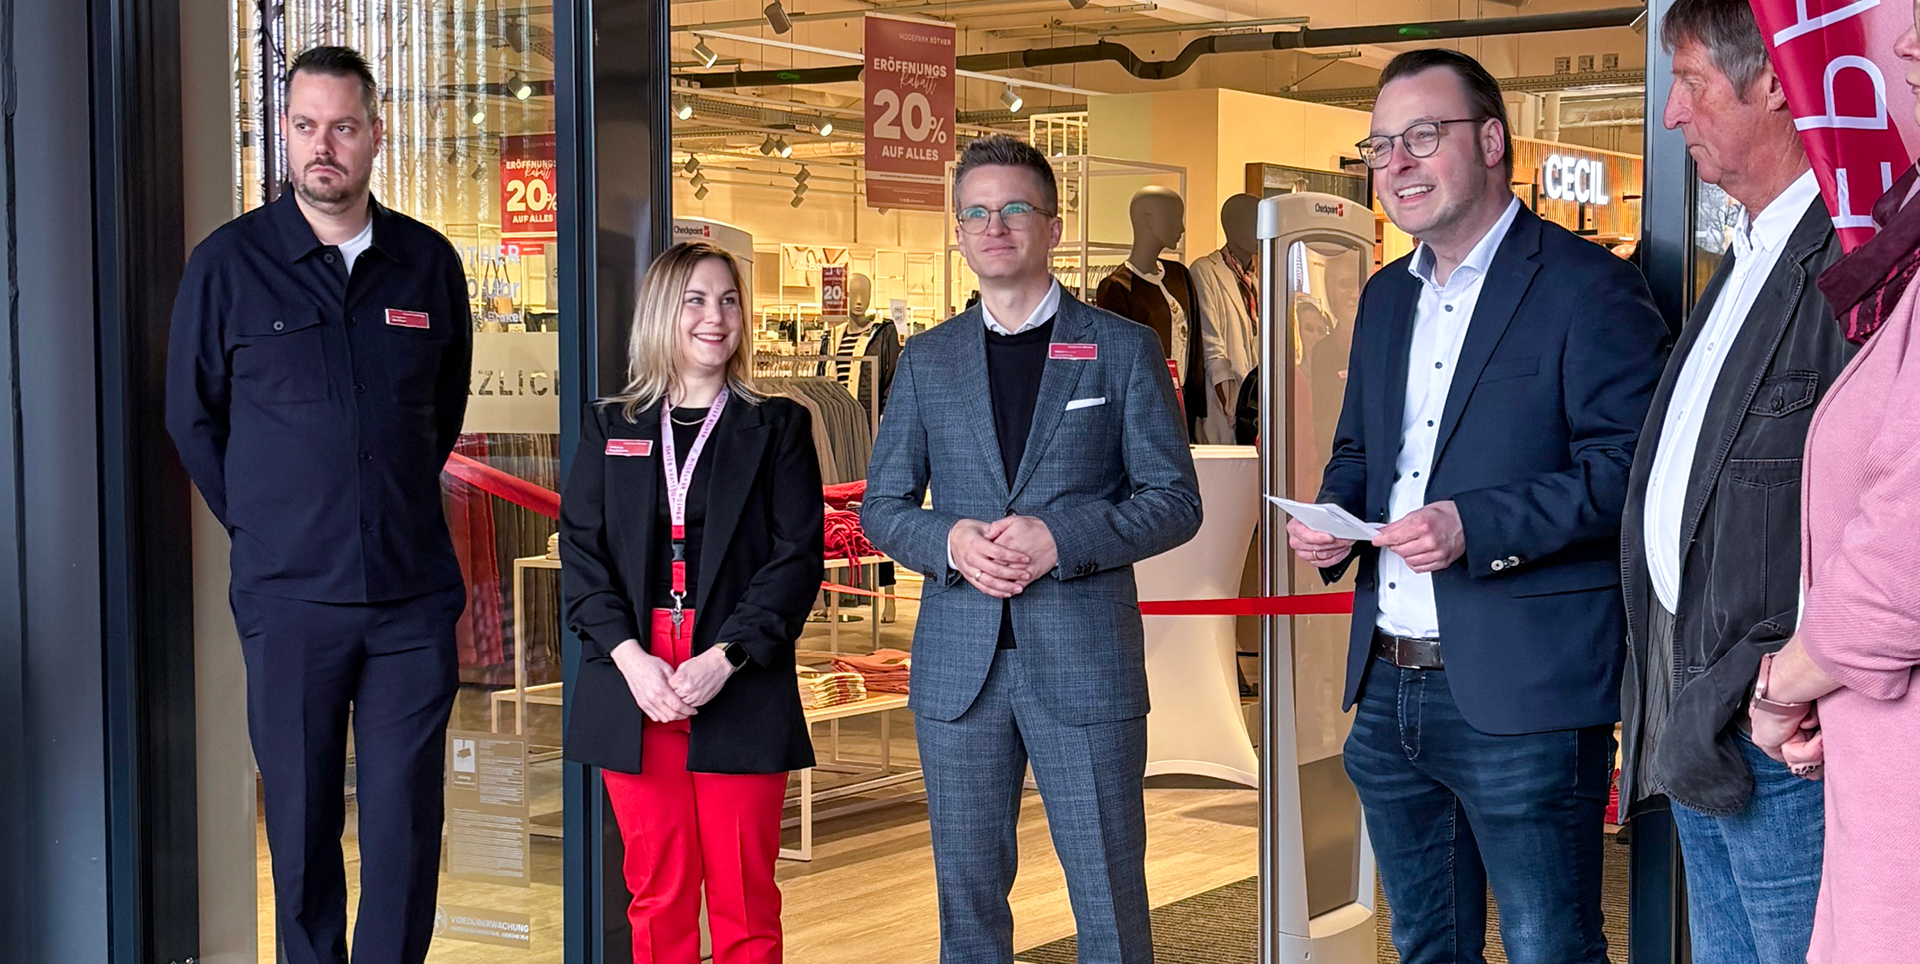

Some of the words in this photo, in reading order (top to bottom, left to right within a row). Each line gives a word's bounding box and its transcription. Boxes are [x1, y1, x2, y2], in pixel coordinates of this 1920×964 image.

[873, 56, 947, 78] ERÖFFNUNGS
[900, 69, 938, 95] Rabatt
[873, 88, 947, 144] 20%
[882, 145, 904, 158] AUF
[905, 147, 939, 161] ALLES
[1545, 154, 1608, 205] CECIL
[512, 215, 529, 224] AUF
[530, 214, 553, 223] ALLES
[674, 226, 703, 236] Checkpoint
